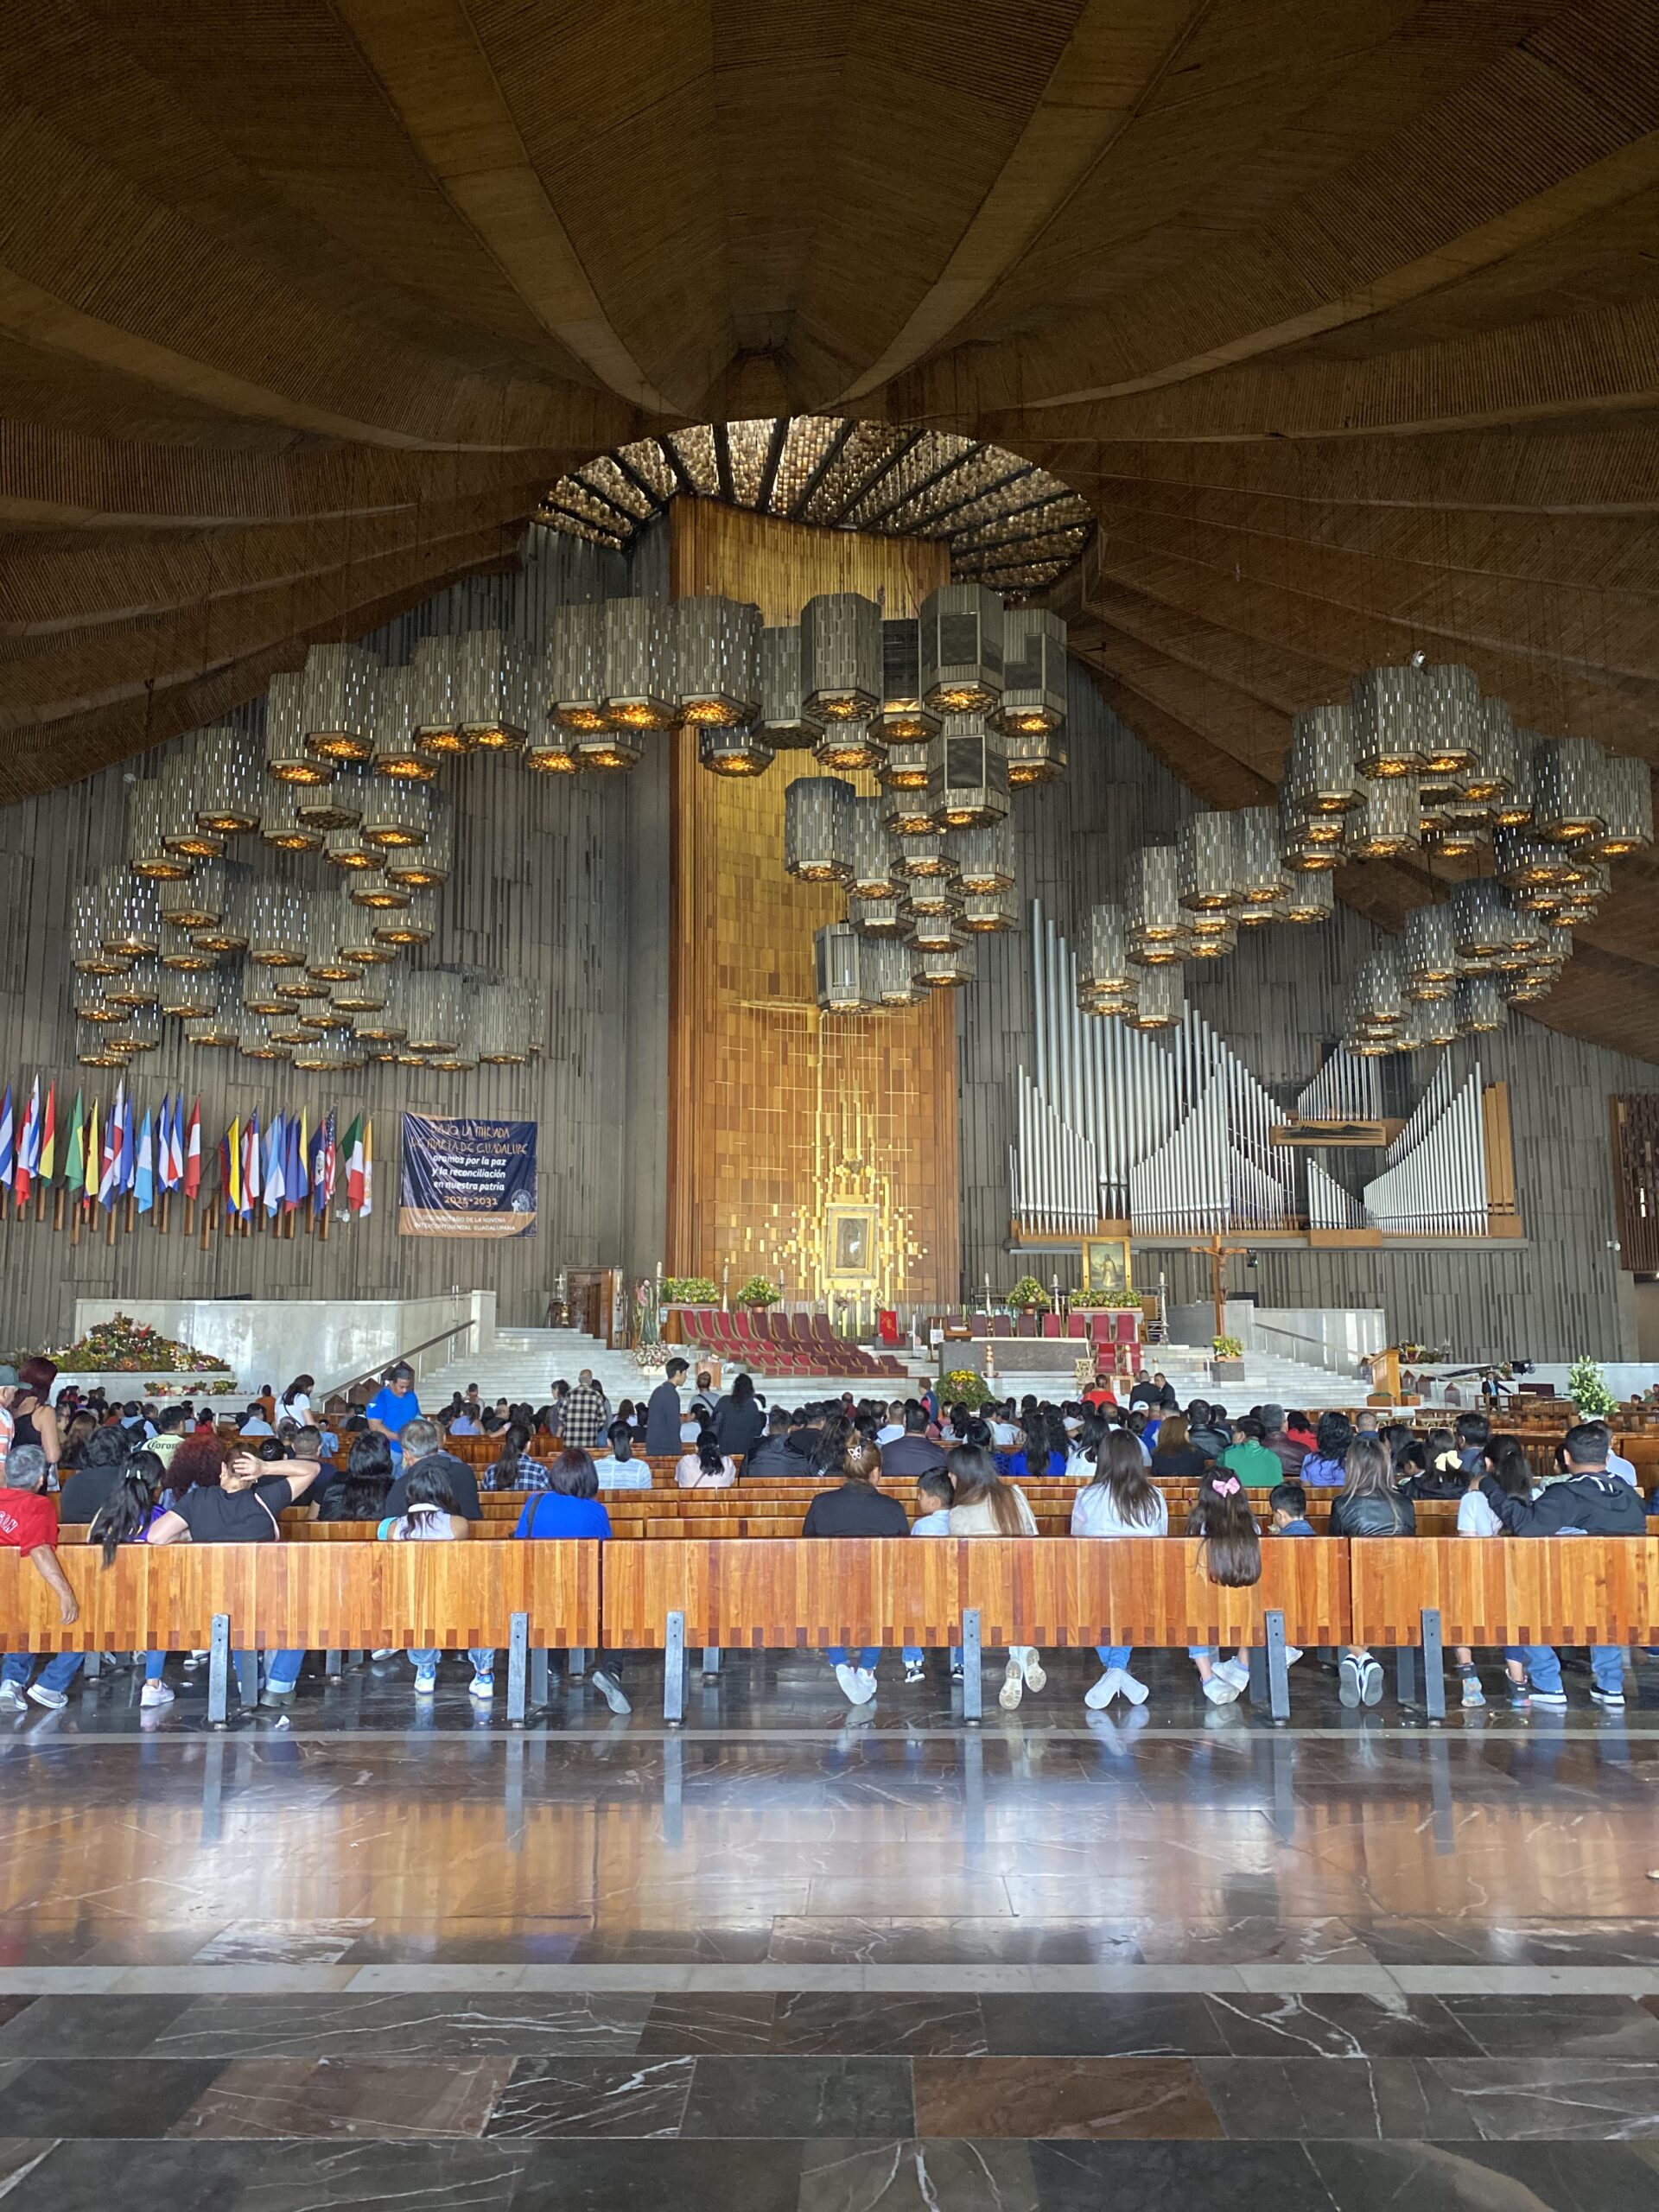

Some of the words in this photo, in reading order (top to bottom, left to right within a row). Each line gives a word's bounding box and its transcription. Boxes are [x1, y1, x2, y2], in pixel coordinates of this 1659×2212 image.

[461, 1125, 473, 1138] LA
[475, 1125, 510, 1139] MIRADA
[461, 1141, 474, 1153] DE
[476, 1142, 528, 1155] GUADALUPE
[433, 1154, 465, 1165] oramos
[465, 1156, 480, 1166] por
[481, 1156, 489, 1165] la
[491, 1159, 507, 1167] paz
[432, 1167, 438, 1176] y
[439, 1166, 448, 1175] la
[449, 1168, 506, 1179] reconciliación
[445, 1181, 478, 1190] nuestra
[479, 1182, 505, 1192] patria
